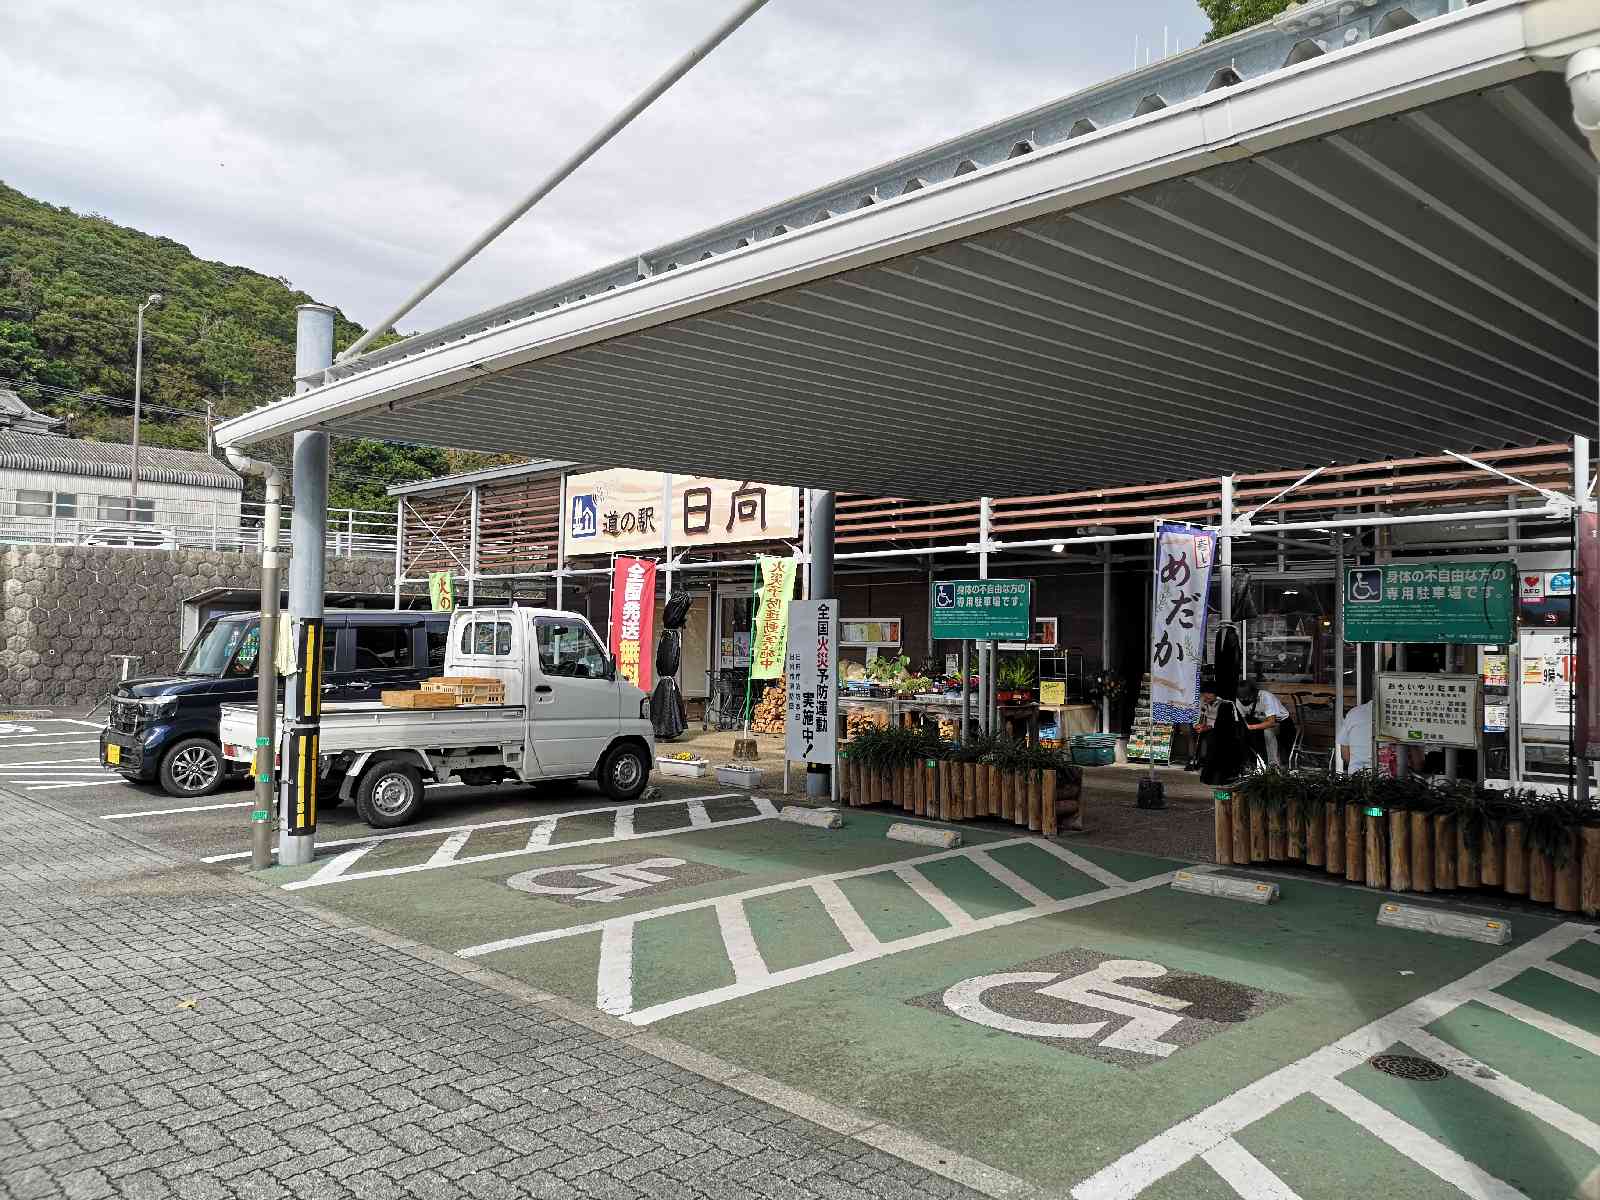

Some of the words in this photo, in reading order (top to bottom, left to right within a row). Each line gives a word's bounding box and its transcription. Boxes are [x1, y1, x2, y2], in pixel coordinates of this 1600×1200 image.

[602, 506, 656, 537] 道の駅
[683, 480, 767, 536] 日向
[956, 584, 1026, 595] 身体の不自由な方の
[1386, 568, 1507, 584] 身体の不自由な方の
[1386, 585, 1504, 601] 専用駐車場です。
[956, 596, 1024, 608] 専用駐車場です。
[1153, 551, 1201, 667] めだか
[815, 603, 830, 733] 全国火災予防運動
[802, 692, 815, 759] 実施中!
